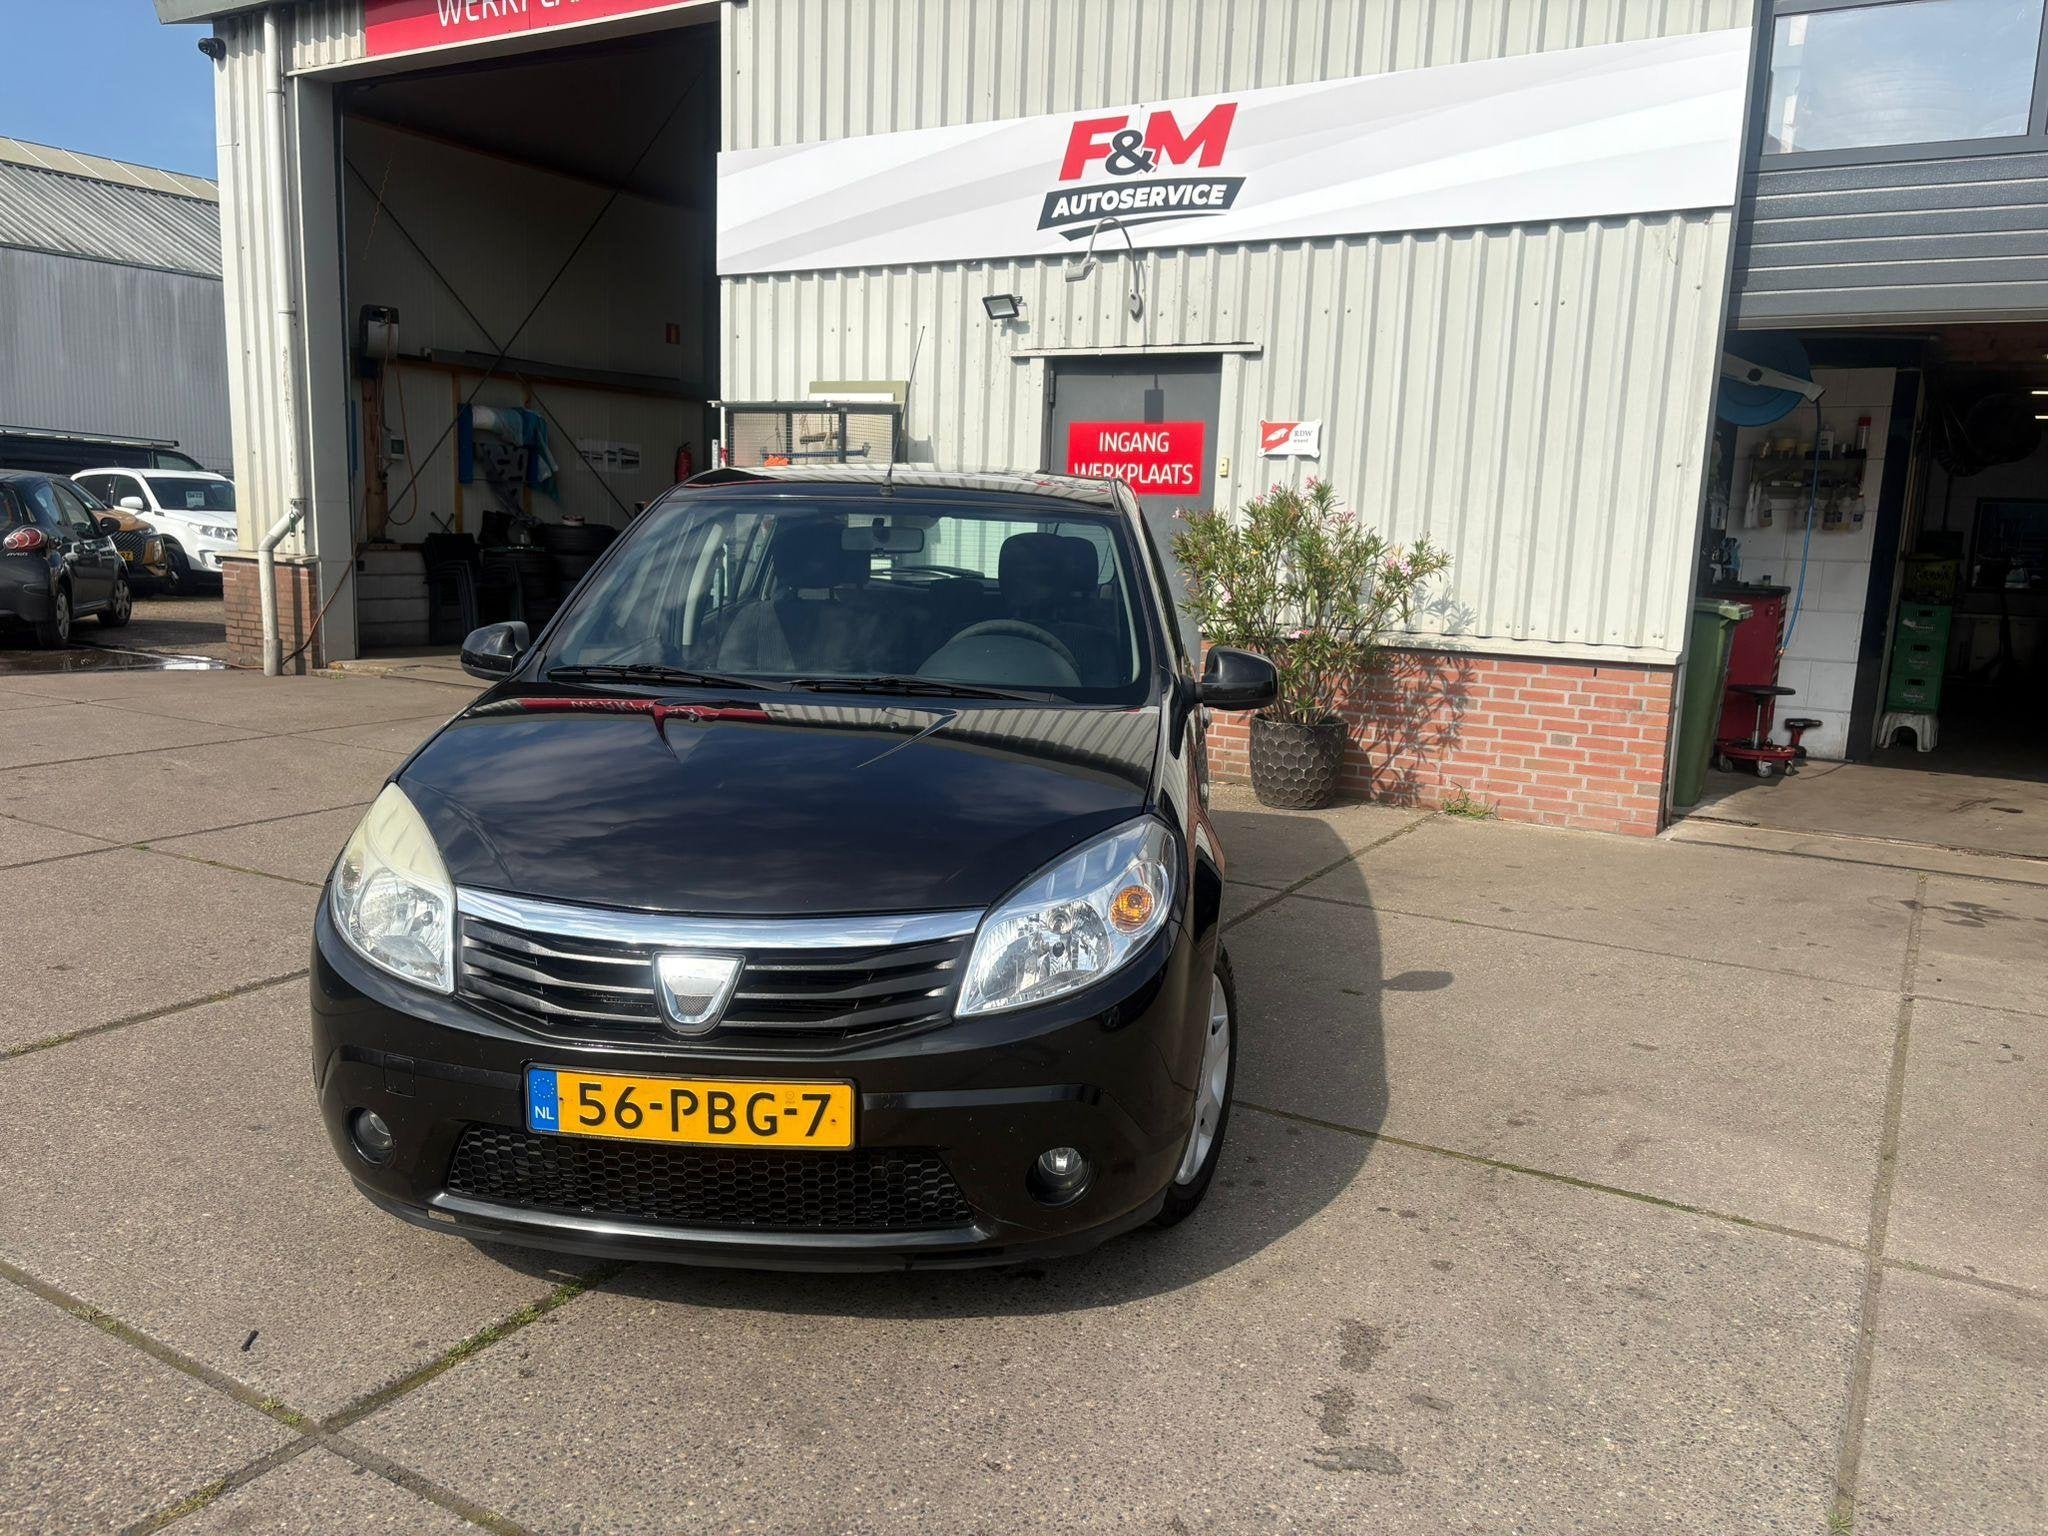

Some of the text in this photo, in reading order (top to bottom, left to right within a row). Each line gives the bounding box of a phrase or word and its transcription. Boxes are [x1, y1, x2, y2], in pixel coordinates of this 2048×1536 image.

[1058, 102, 1238, 181] F&M
[1051, 184, 1227, 219] AUTOSERVICE
[1098, 431, 1170, 453] INGANG
[534, 1105, 555, 1121] NL
[578, 1082, 832, 1137] 56-PBG-7
